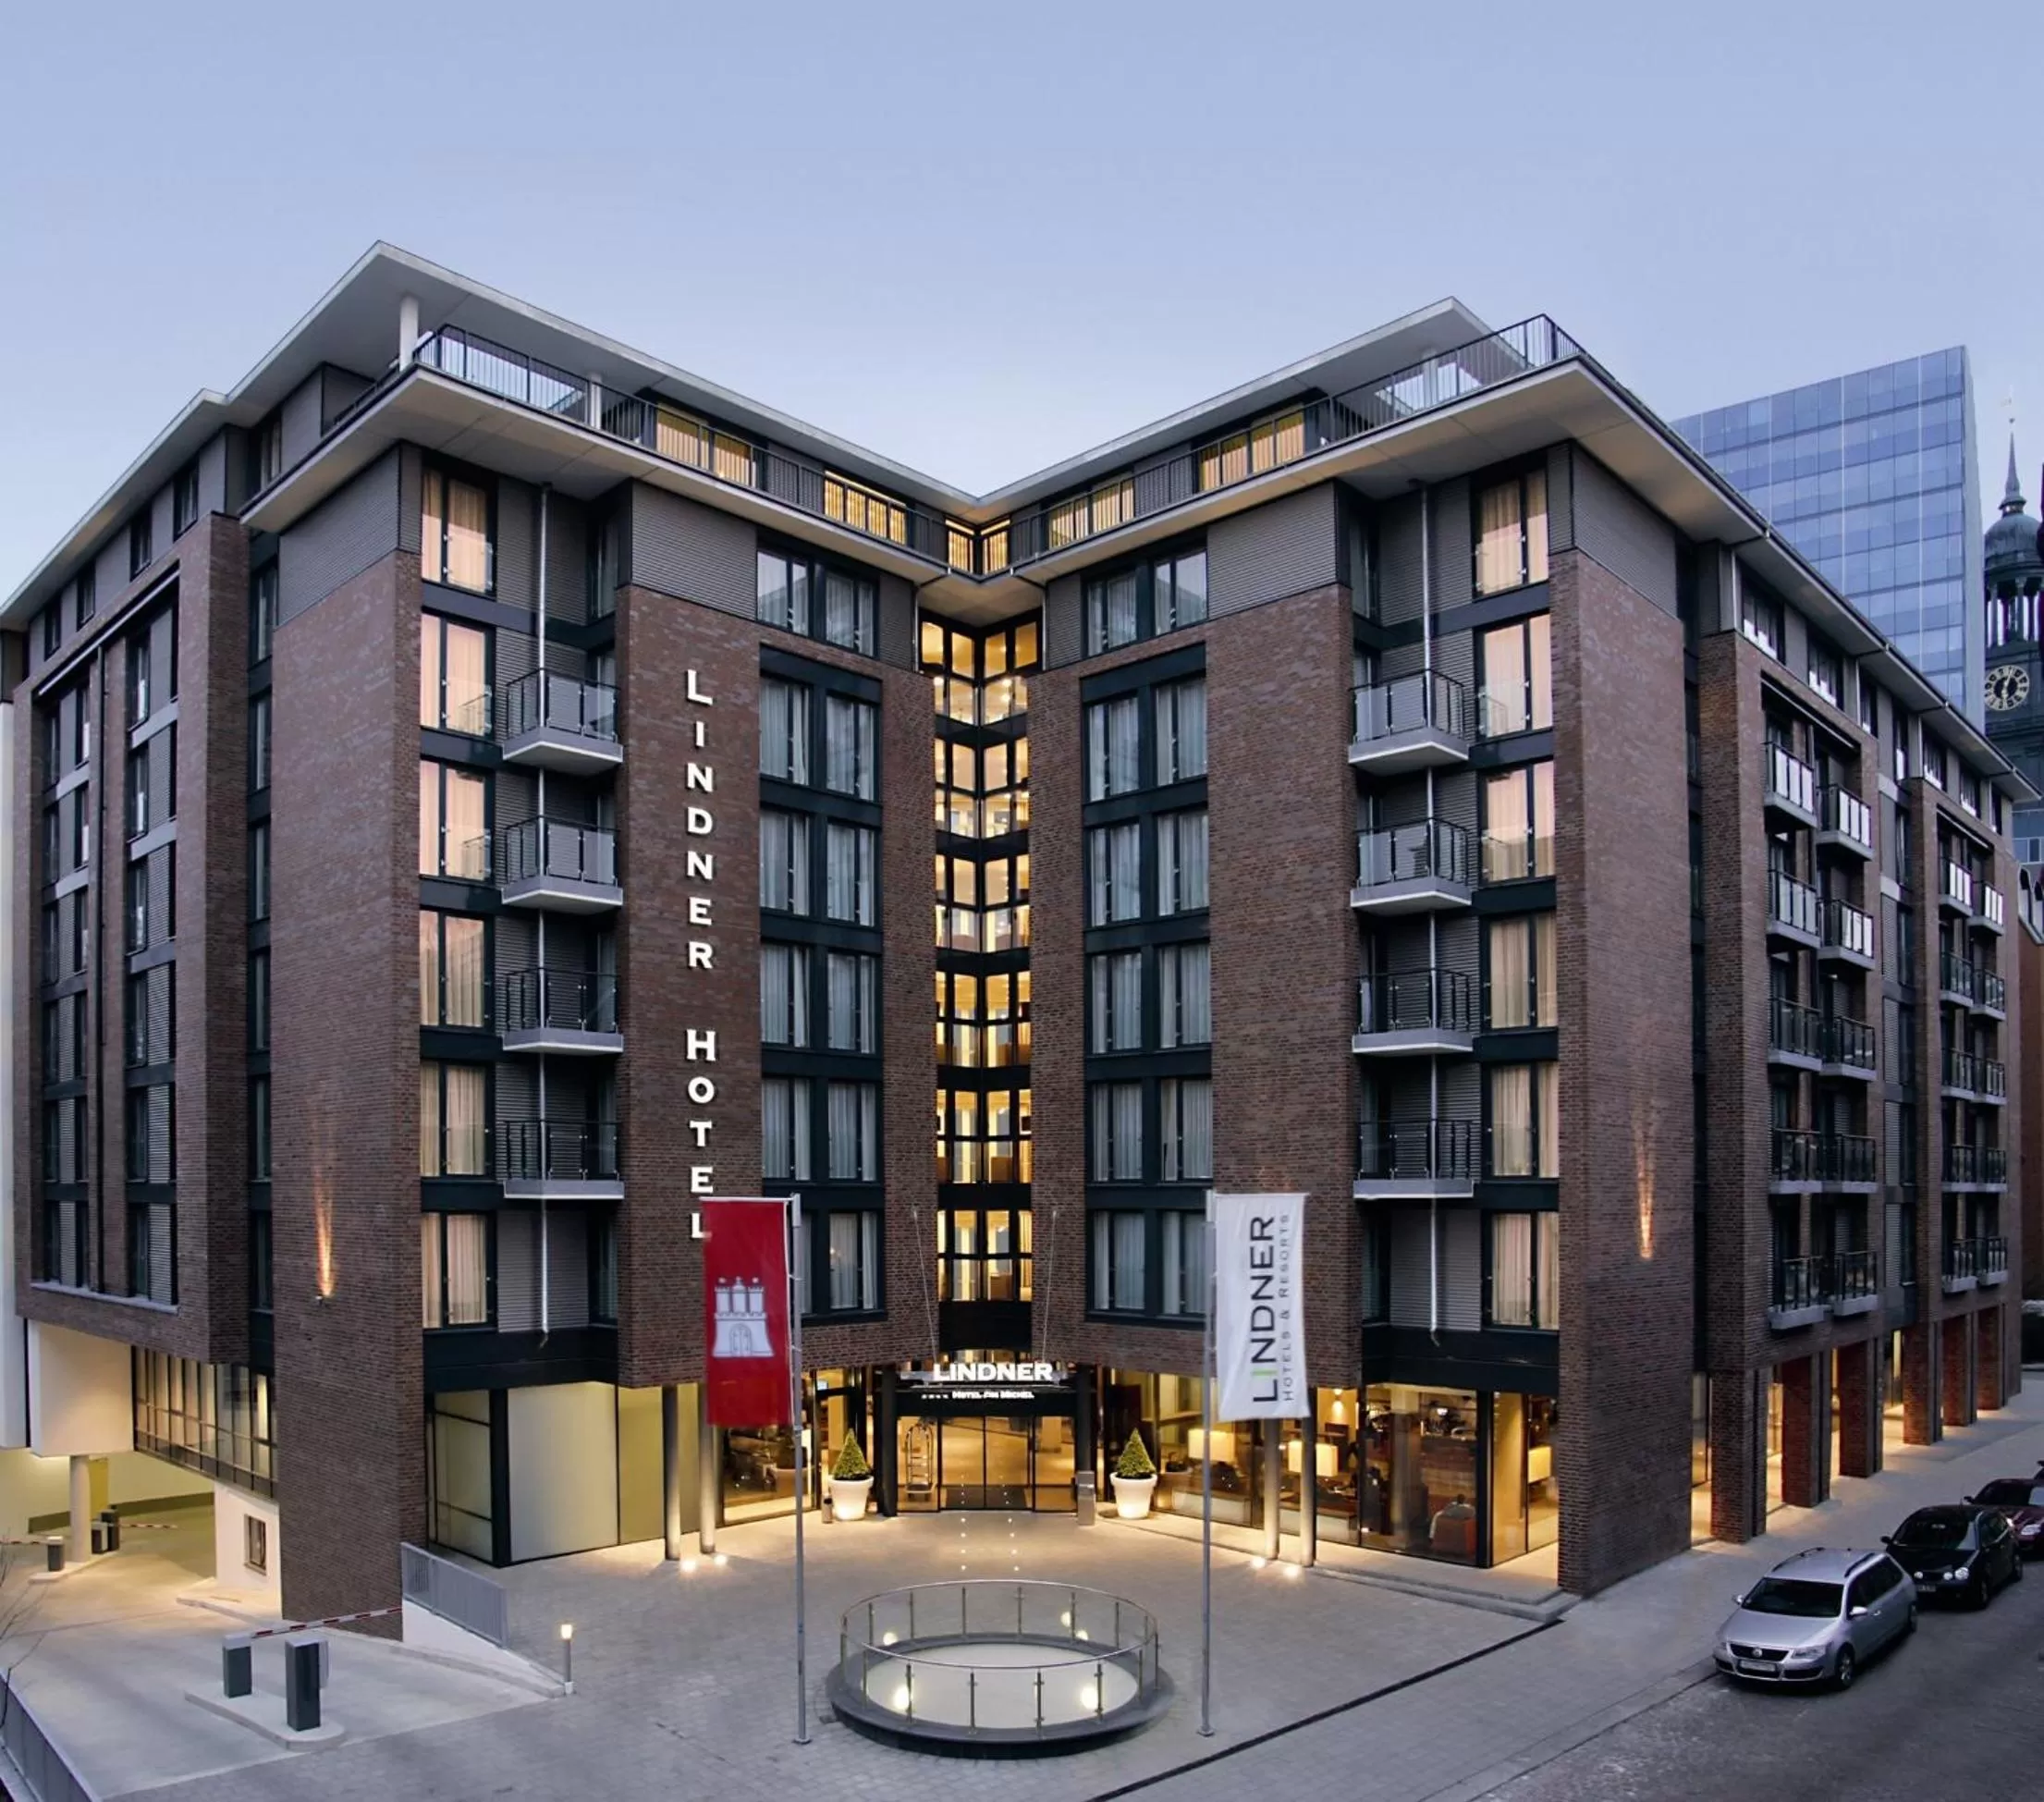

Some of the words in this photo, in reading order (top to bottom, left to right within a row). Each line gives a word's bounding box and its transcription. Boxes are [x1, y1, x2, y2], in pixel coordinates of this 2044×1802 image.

[687, 669, 713, 969] LINDNER
[687, 1029, 716, 1238] HOTEL
[1279, 1214, 1291, 1298] RESORTS
[1250, 1216, 1279, 1403] LINDNER
[1280, 1309, 1291, 1320] &
[933, 1362, 1053, 1381] LINDNER
[1281, 1331, 1293, 1402] HOTELS
